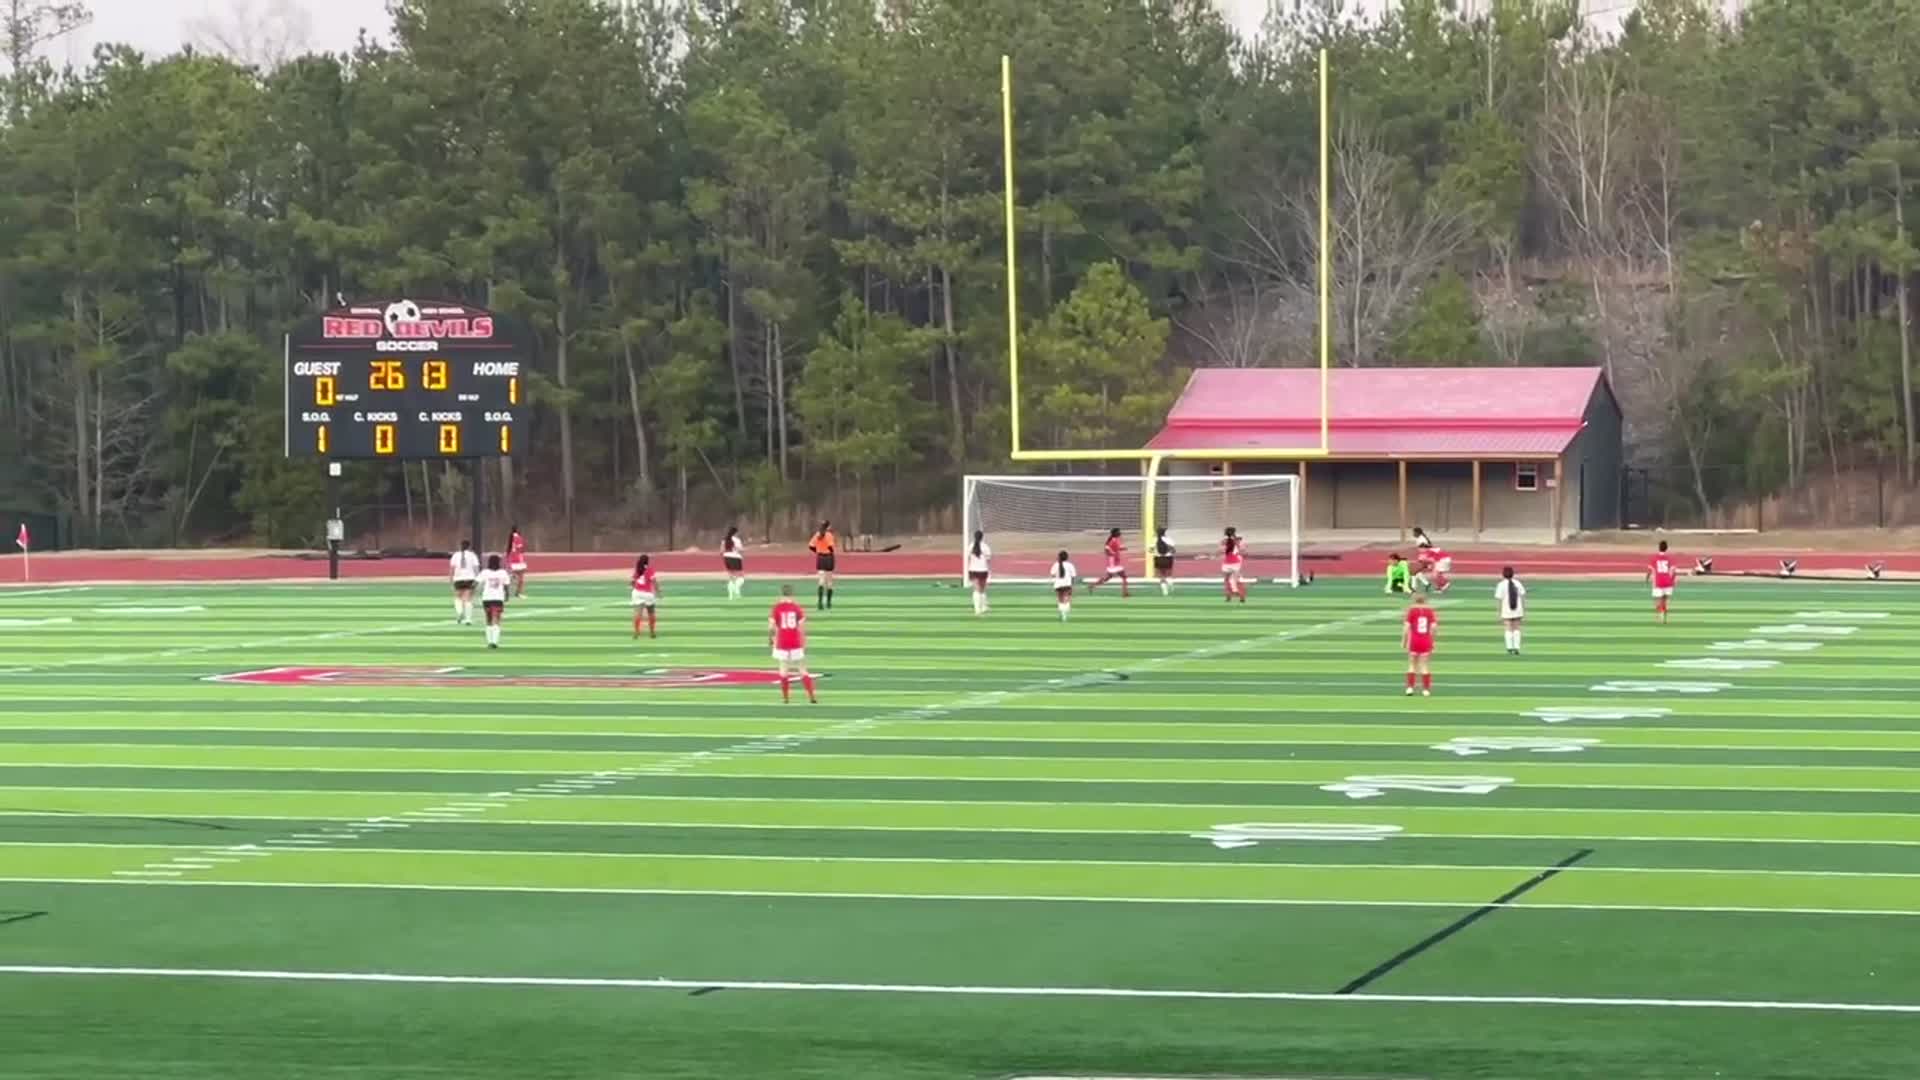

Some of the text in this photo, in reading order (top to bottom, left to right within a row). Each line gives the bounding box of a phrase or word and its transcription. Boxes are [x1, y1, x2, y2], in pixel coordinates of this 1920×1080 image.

[323, 316, 493, 338] RED DEVILS
[376, 340, 438, 351] SOCCER
[294, 361, 342, 376] GUEST
[369, 361, 447, 390] 26 13
[472, 361, 520, 376] HOME
[316, 376, 334, 405] 0
[509, 377, 517, 405] 1
[353, 412, 398, 422] C. KICKS
[418, 412, 463, 422] C. KICKS
[318, 425, 326, 453] 1
[375, 425, 393, 453] 0
[440, 425, 458, 453] 0
[501, 425, 508, 453] 1
[1416, 616, 1428, 633] 2
